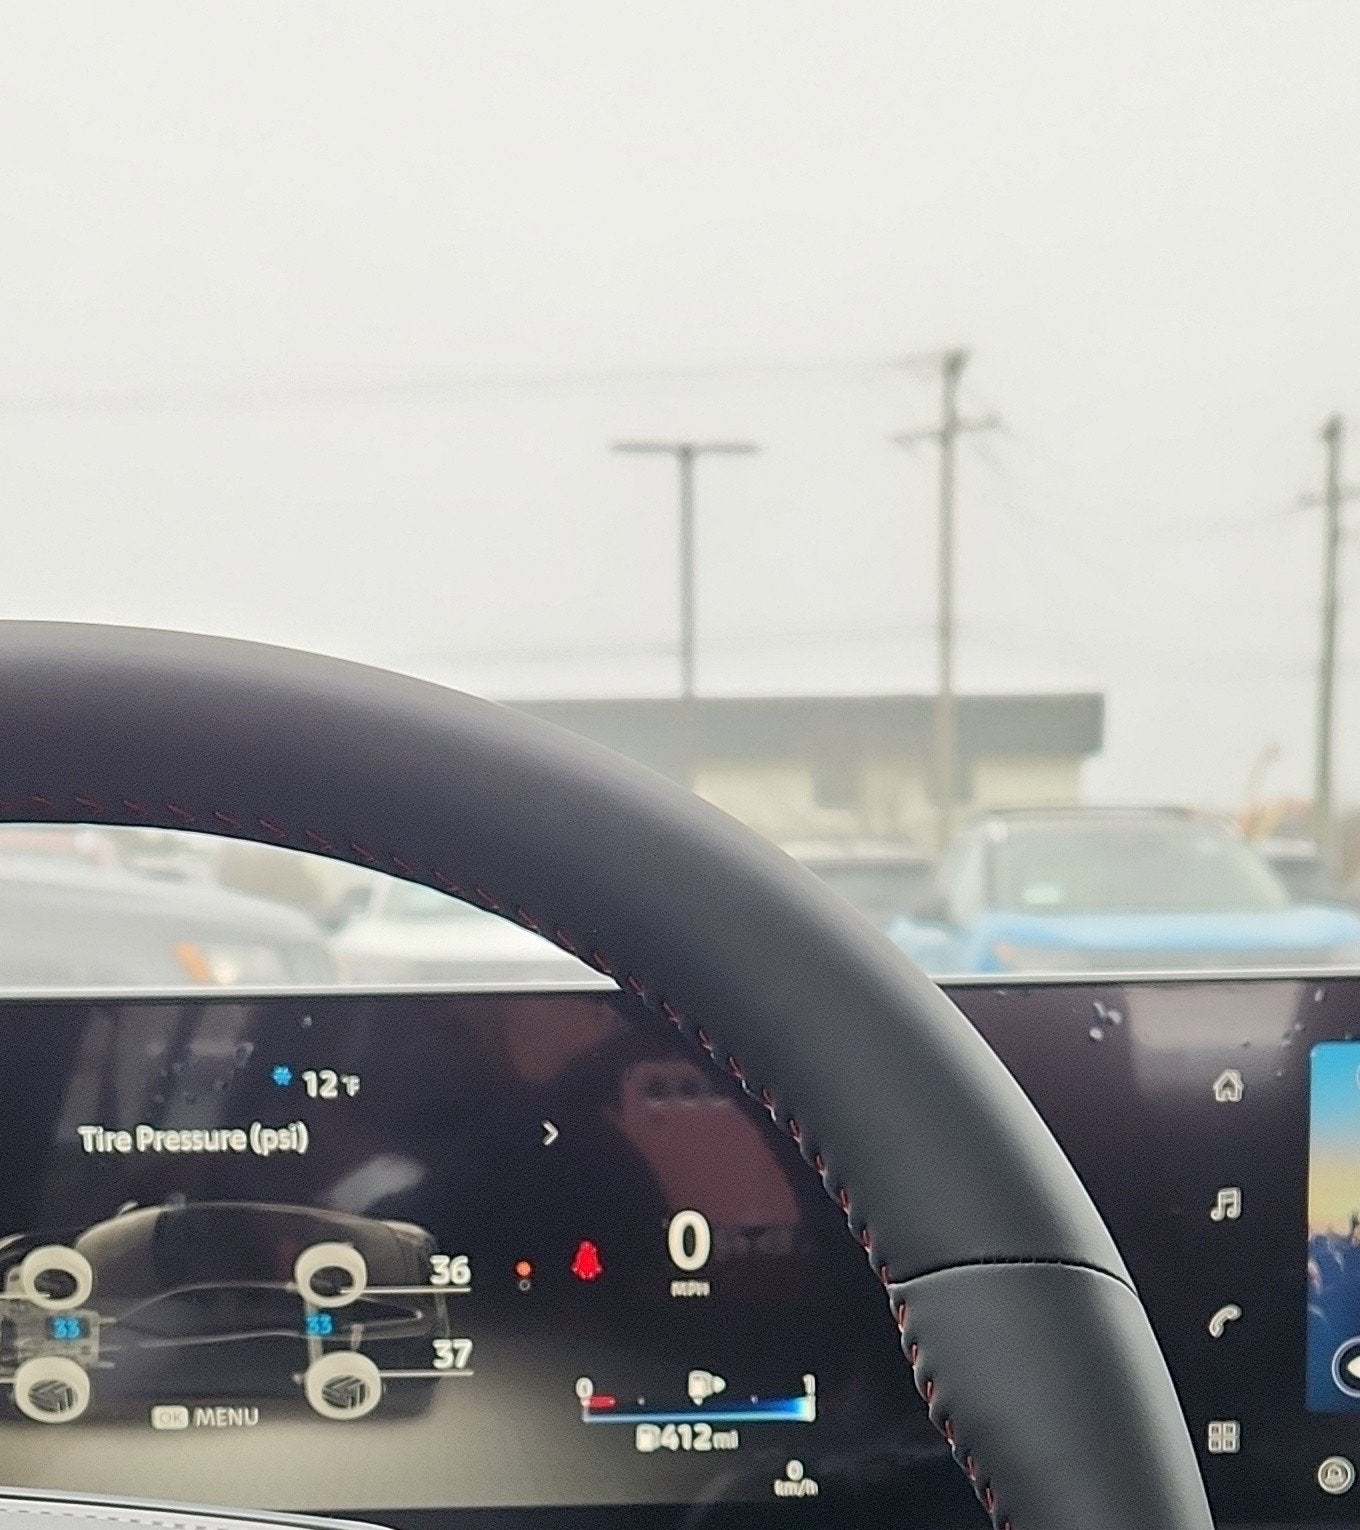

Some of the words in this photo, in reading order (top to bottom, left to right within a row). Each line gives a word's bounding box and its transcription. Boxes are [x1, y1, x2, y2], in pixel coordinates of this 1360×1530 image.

[76, 1124, 132, 1153] Tire
[135, 1123, 248, 1153] Pressure
[249, 1120, 309, 1157] (psi)
[667, 1209, 711, 1271] 0
[429, 1254, 472, 1286] 36
[669, 1280, 711, 1297] MPH
[432, 1338, 474, 1370] 37
[575, 1376, 594, 1399] 0
[803, 1373, 816, 1397] 1
[193, 1405, 260, 1428] MENU
[785, 1459, 804, 1481] 0
[773, 1478, 819, 1497] km/h
